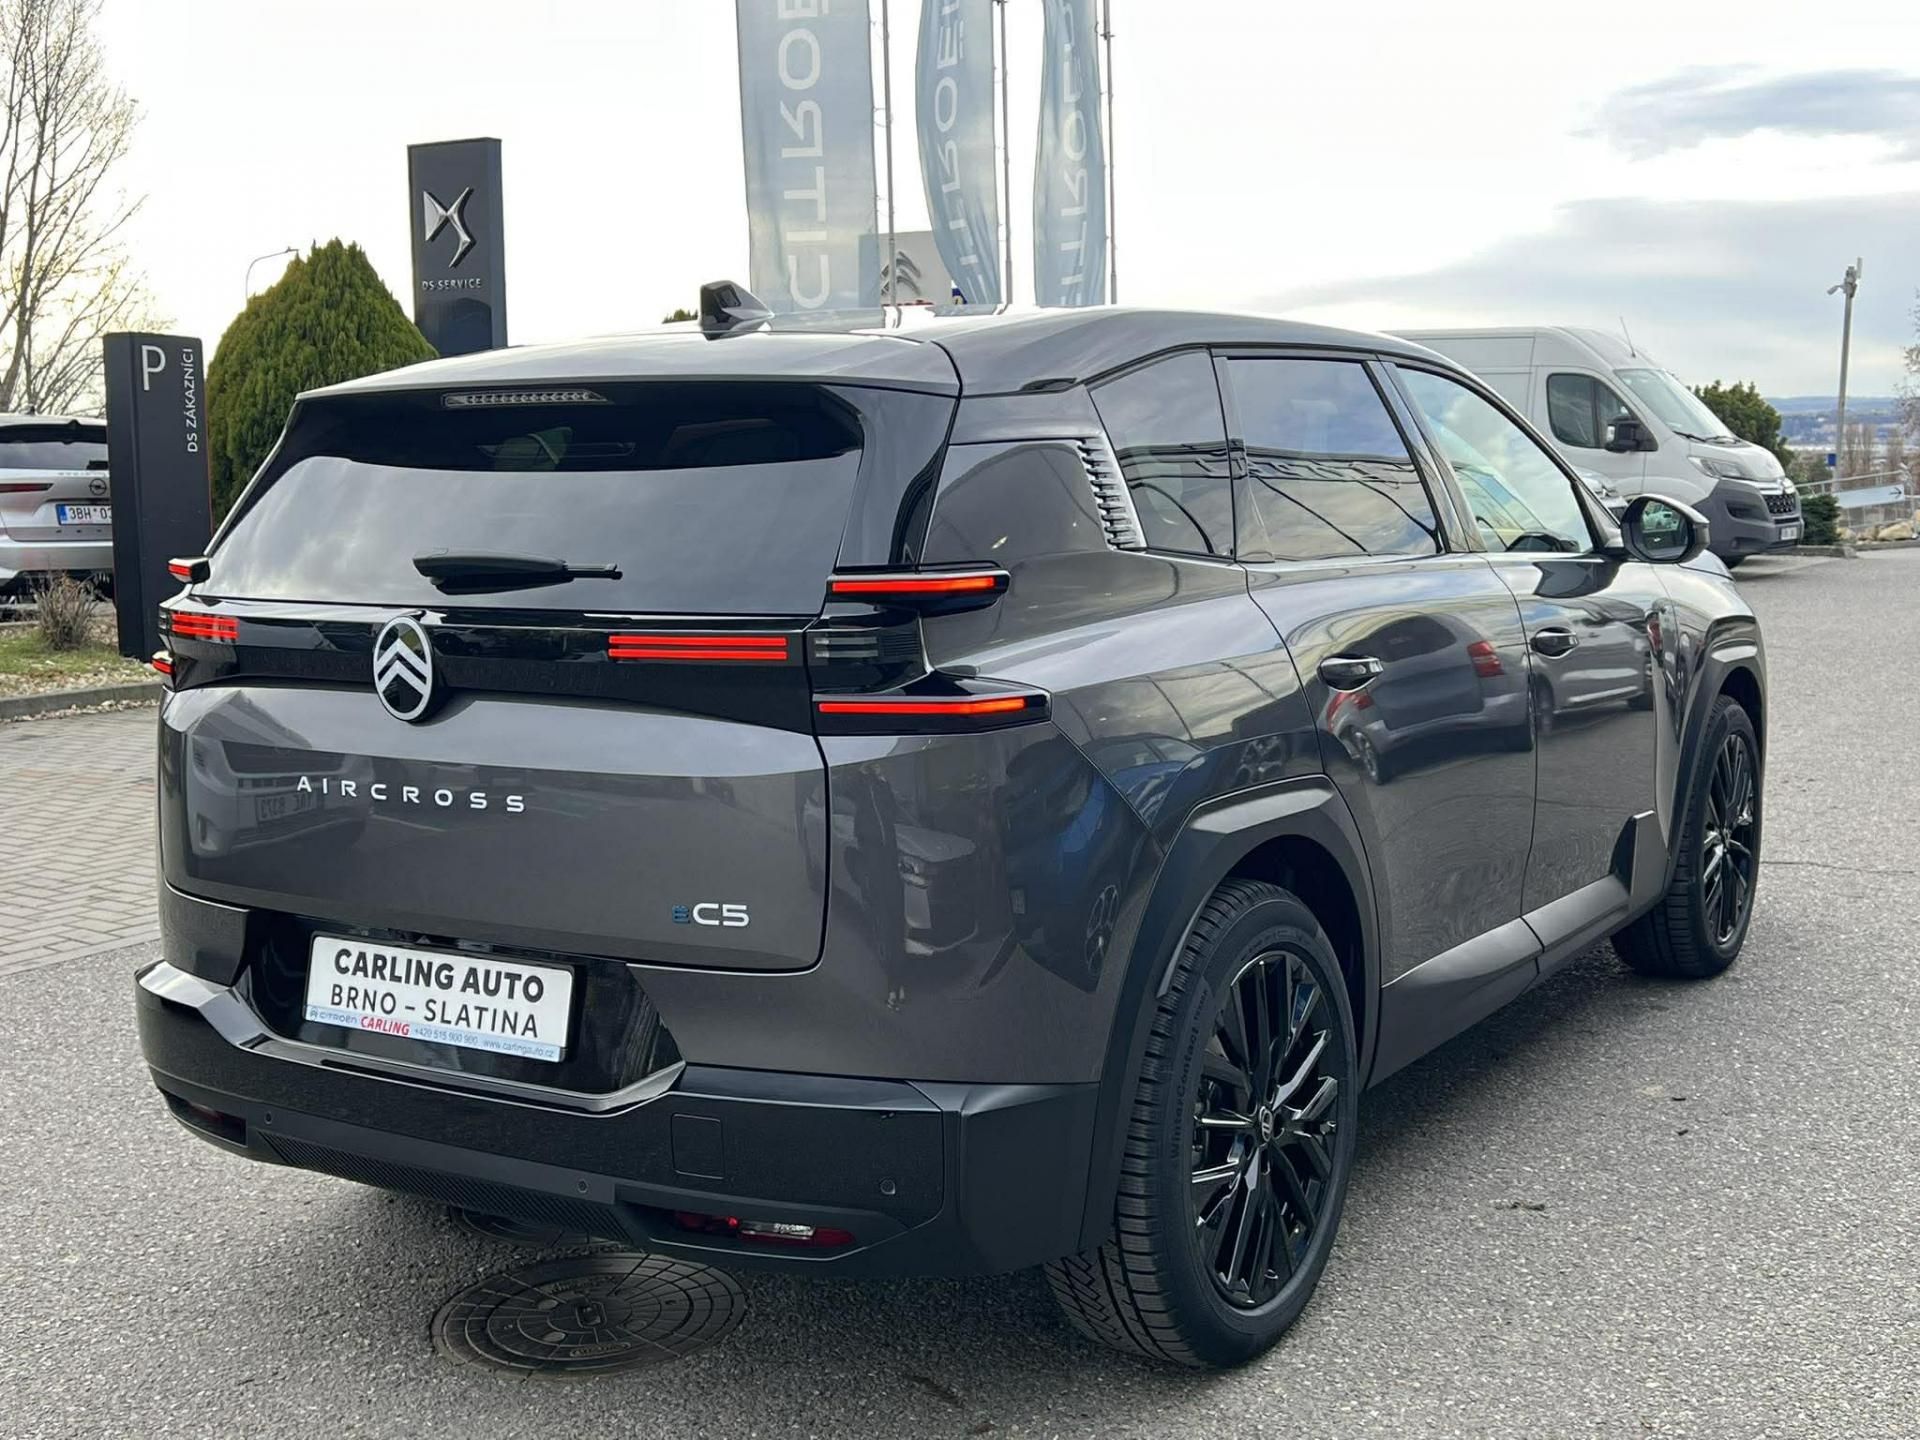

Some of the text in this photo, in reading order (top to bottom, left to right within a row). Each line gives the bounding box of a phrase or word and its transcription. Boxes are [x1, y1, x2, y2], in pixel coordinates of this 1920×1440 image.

[421, 278, 482, 290] DS SERVICE
[141, 344, 167, 391] P
[181, 348, 198, 453] DS ZÁKAZNÍCI
[69, 507, 91, 520] 3BH
[296, 775, 525, 813] AIRCROSS
[334, 947, 545, 1003] CARLING AUTO
[330, 983, 397, 1015] BRNO
[423, 997, 538, 1038] SLATINA
[360, 1016, 410, 1036] CARLING
[434, 1030, 448, 1040] 515
